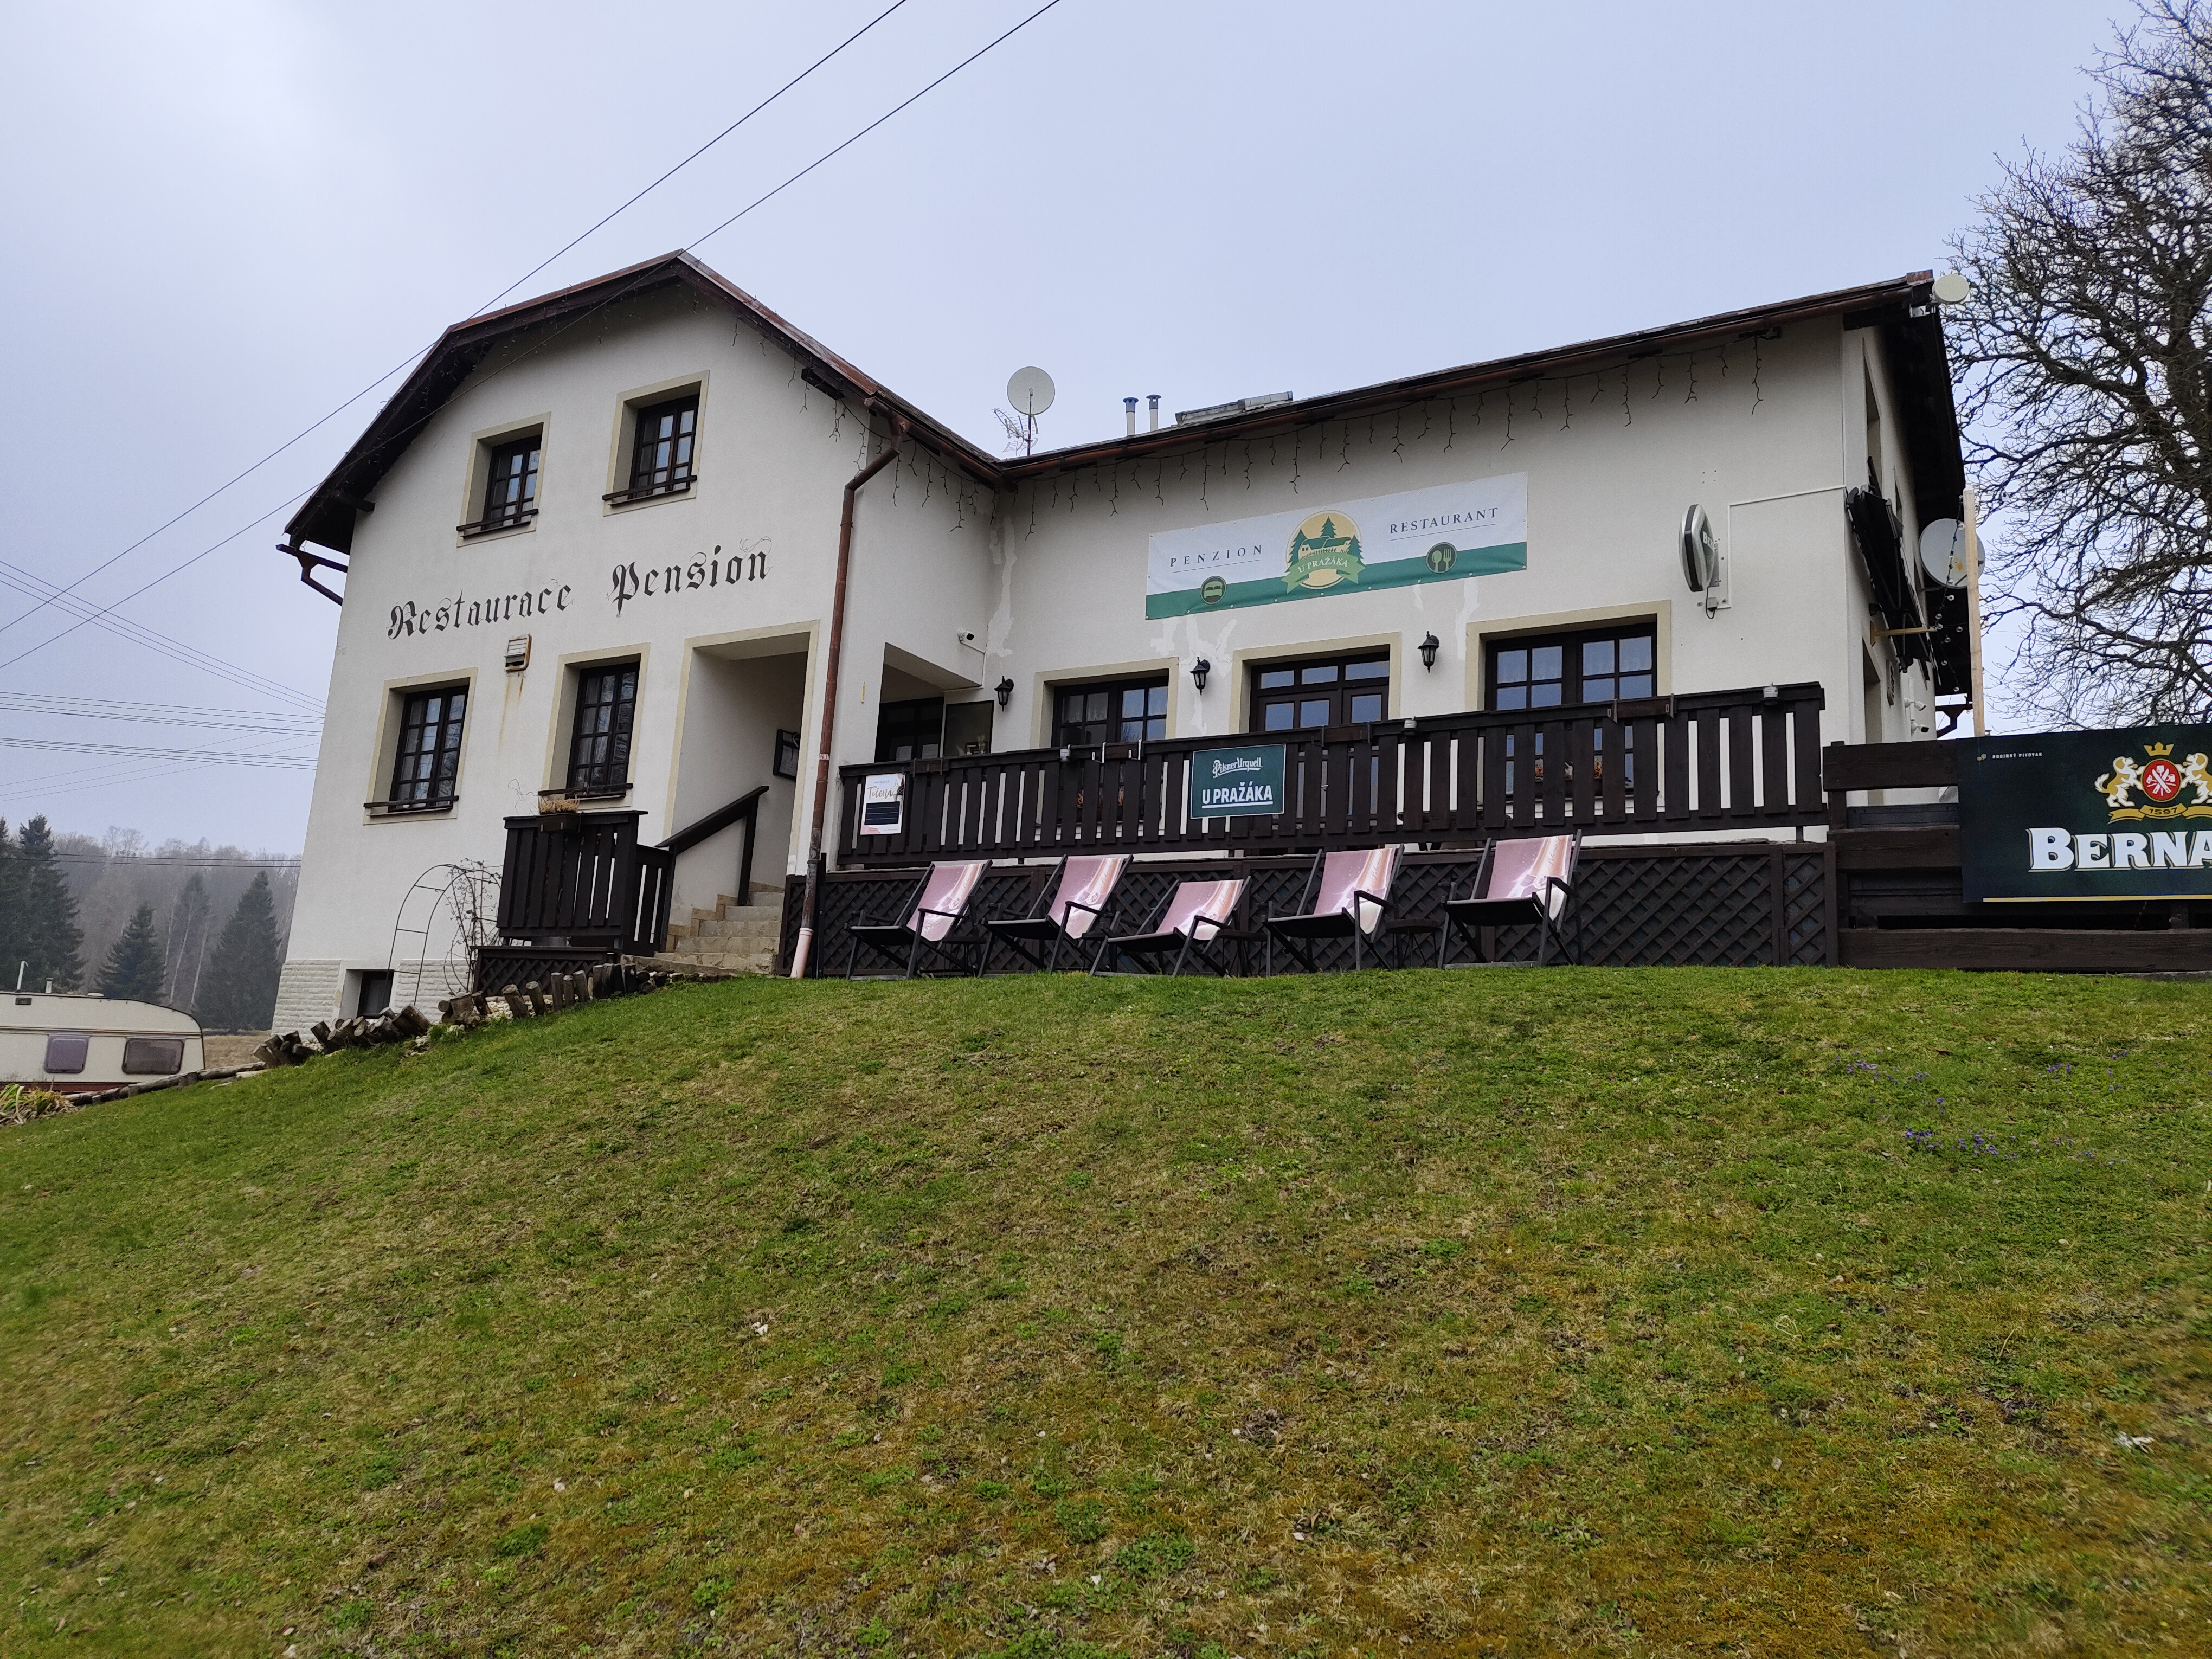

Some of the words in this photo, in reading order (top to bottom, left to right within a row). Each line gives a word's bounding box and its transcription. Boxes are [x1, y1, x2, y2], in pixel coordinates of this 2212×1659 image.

[1389, 507, 1499, 534] RESTAURANT
[1170, 544, 1262, 567] PENZION
[1298, 564, 1305, 573] U
[1307, 556, 1348, 569] PRAŽÁKA
[387, 581, 574, 640] Restaurace
[607, 538, 773, 617] Pension
[1212, 759, 1238, 779] Pilsner
[1236, 756, 1262, 772] Urquell
[866, 786, 893, 800] Točená
[1201, 789, 1211, 805] U
[1213, 781, 1273, 804] PRAŽÁKA
